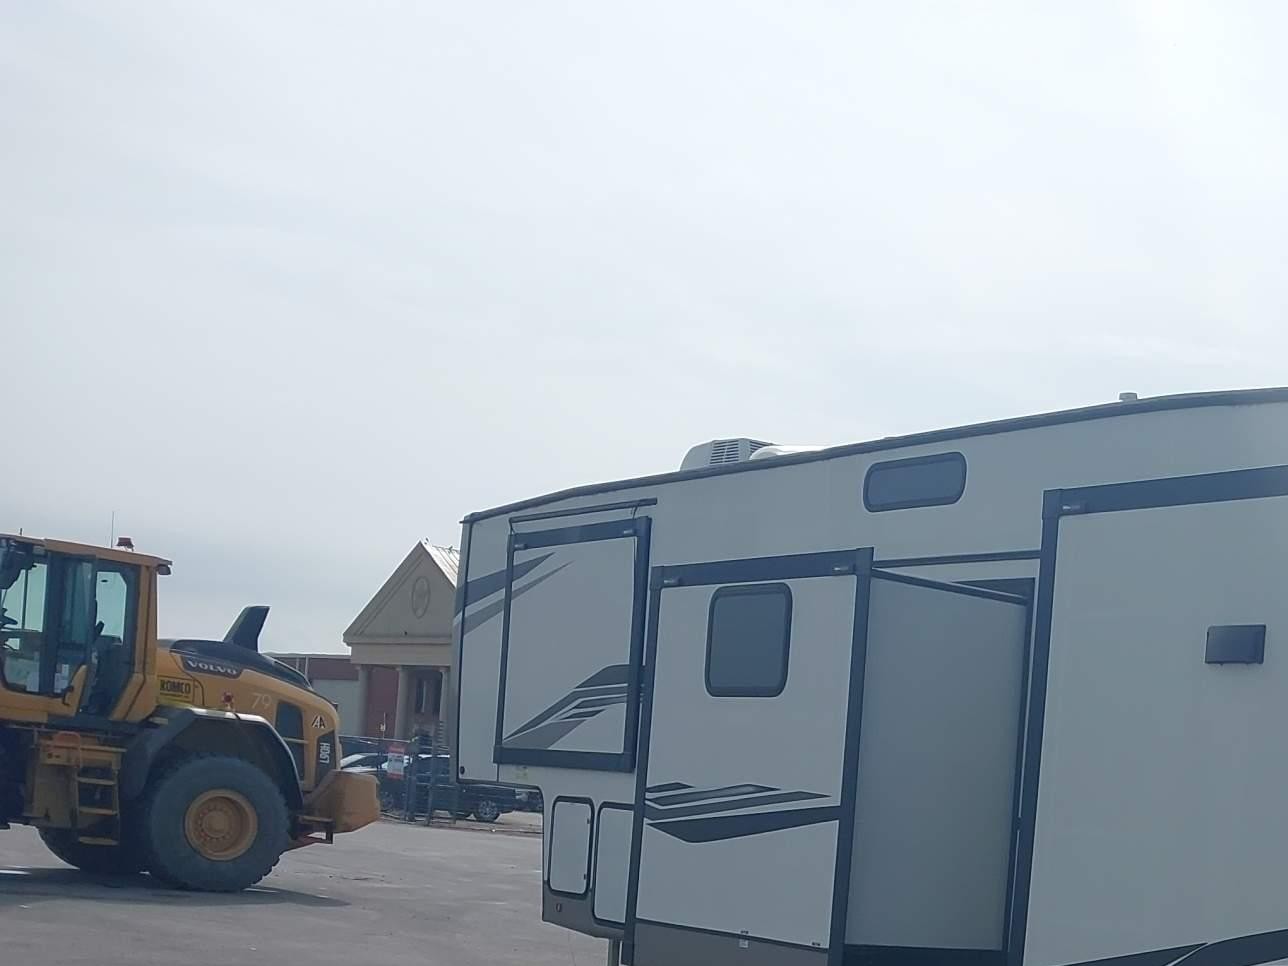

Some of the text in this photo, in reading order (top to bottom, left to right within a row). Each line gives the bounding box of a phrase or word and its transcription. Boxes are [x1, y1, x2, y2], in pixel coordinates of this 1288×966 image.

[187, 660, 237, 675] VOLVO
[160, 679, 191, 694] ROMCO
[252, 693, 273, 710] 79
